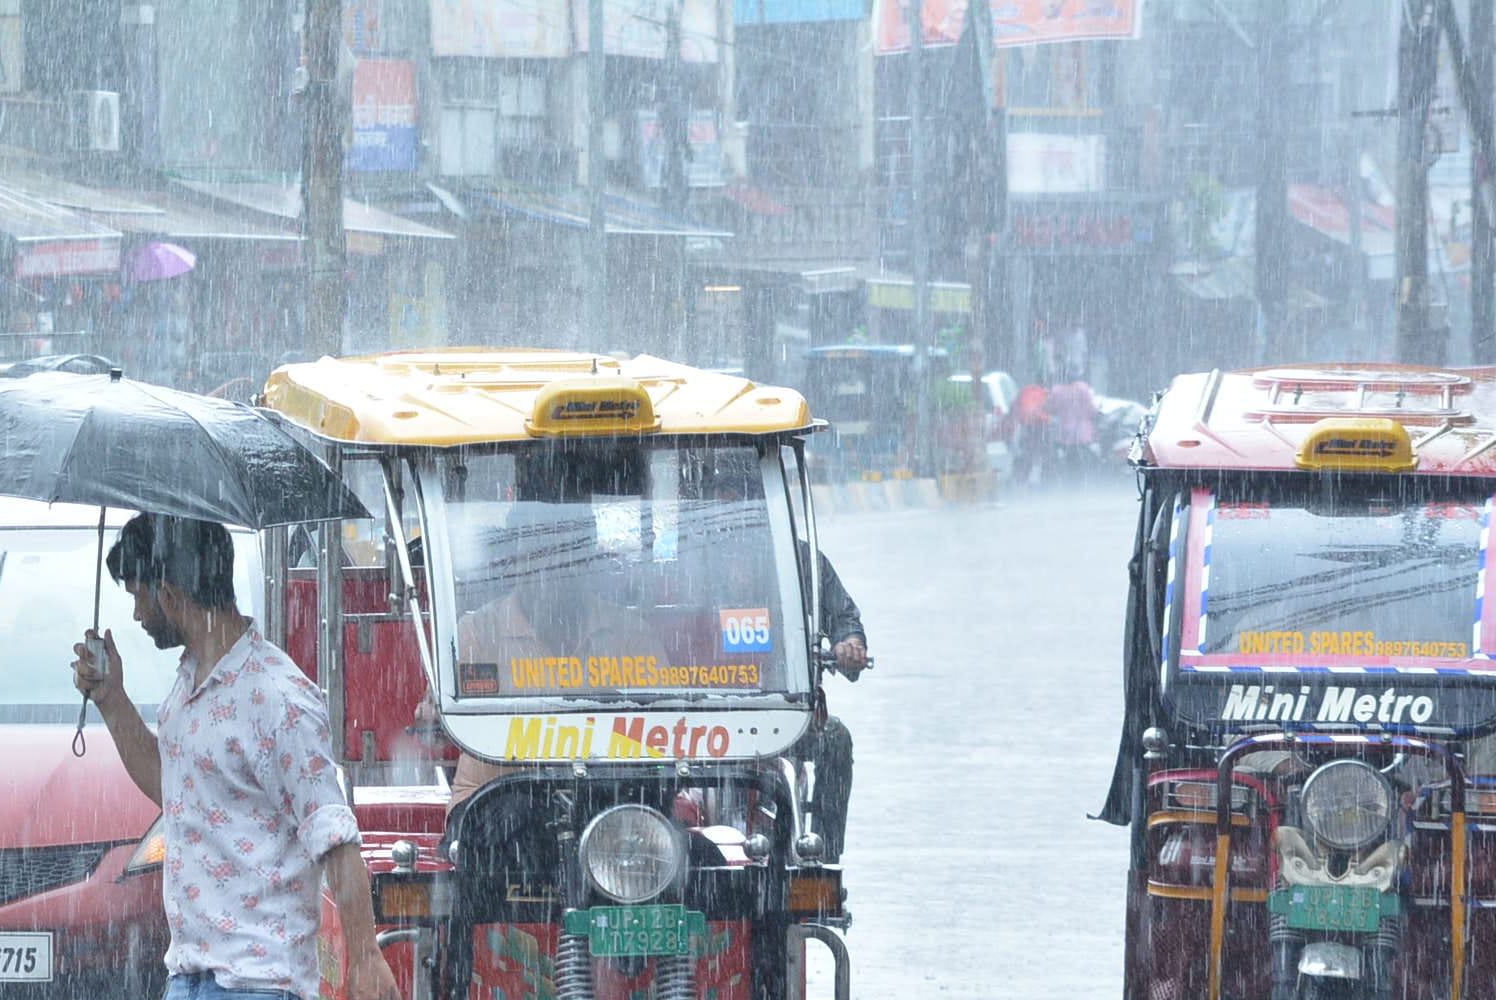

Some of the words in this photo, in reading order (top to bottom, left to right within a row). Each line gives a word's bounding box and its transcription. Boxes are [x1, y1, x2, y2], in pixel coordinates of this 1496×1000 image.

[725, 616, 770, 645] 065
[1240, 631, 1304, 655] UNITED
[1310, 631, 1375, 656] SPARES
[511, 656, 583, 689] UNITED
[588, 655, 658, 687] SPARES
[658, 665, 758, 686] 9897640753
[1221, 684, 1311, 721] Mini
[1316, 686, 1434, 723] Metro
[504, 717, 596, 760] Mini
[608, 716, 730, 759] Metro
